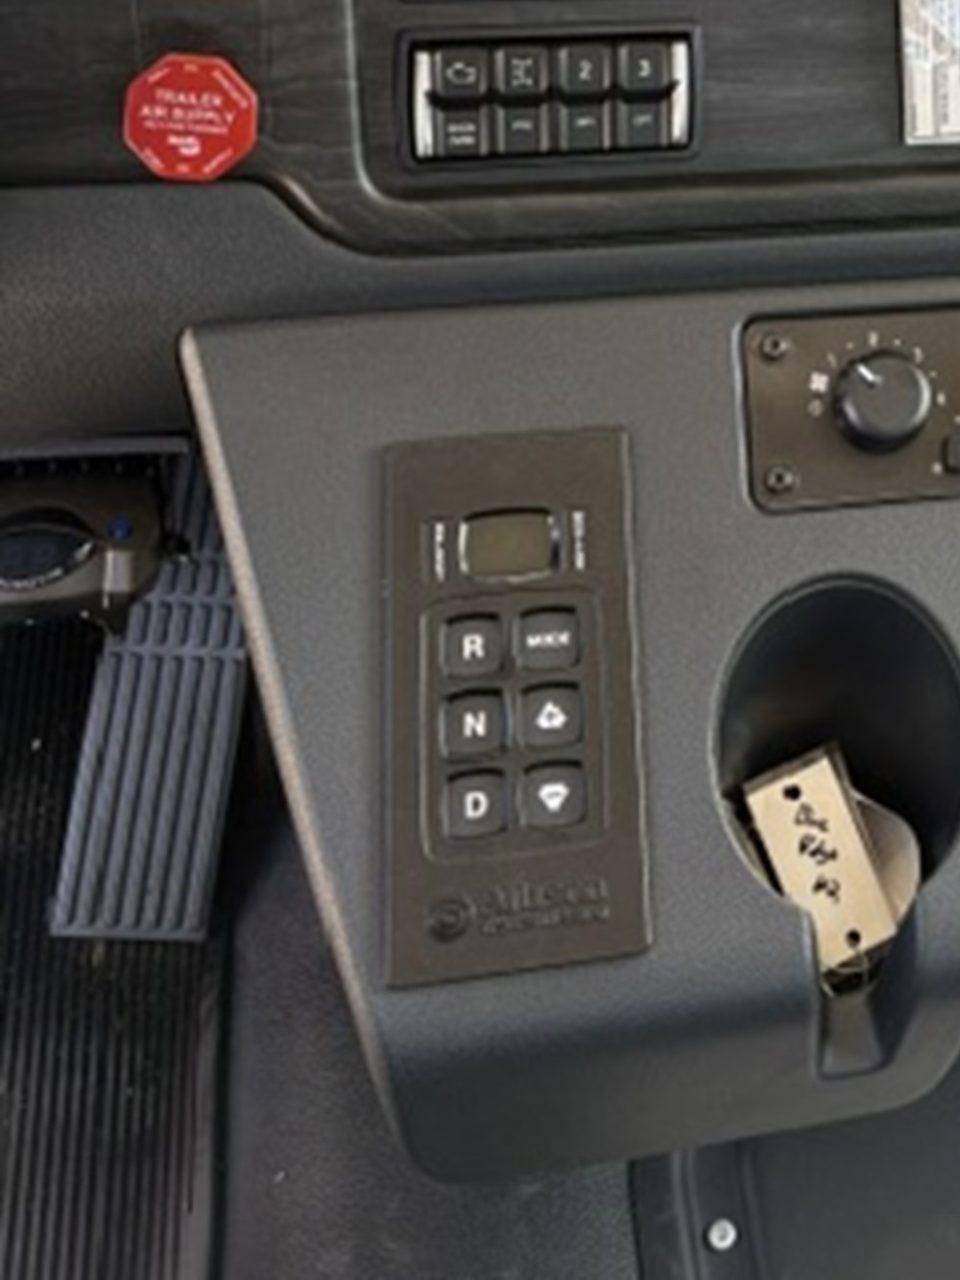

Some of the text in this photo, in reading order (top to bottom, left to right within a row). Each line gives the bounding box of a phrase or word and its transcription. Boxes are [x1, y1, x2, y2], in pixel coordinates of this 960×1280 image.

[154, 87, 222, 107] TRAILER
[462, 633, 486, 661] R
[526, 631, 571, 648] MODE
[463, 712, 486, 738] N
[465, 792, 488, 819] D
